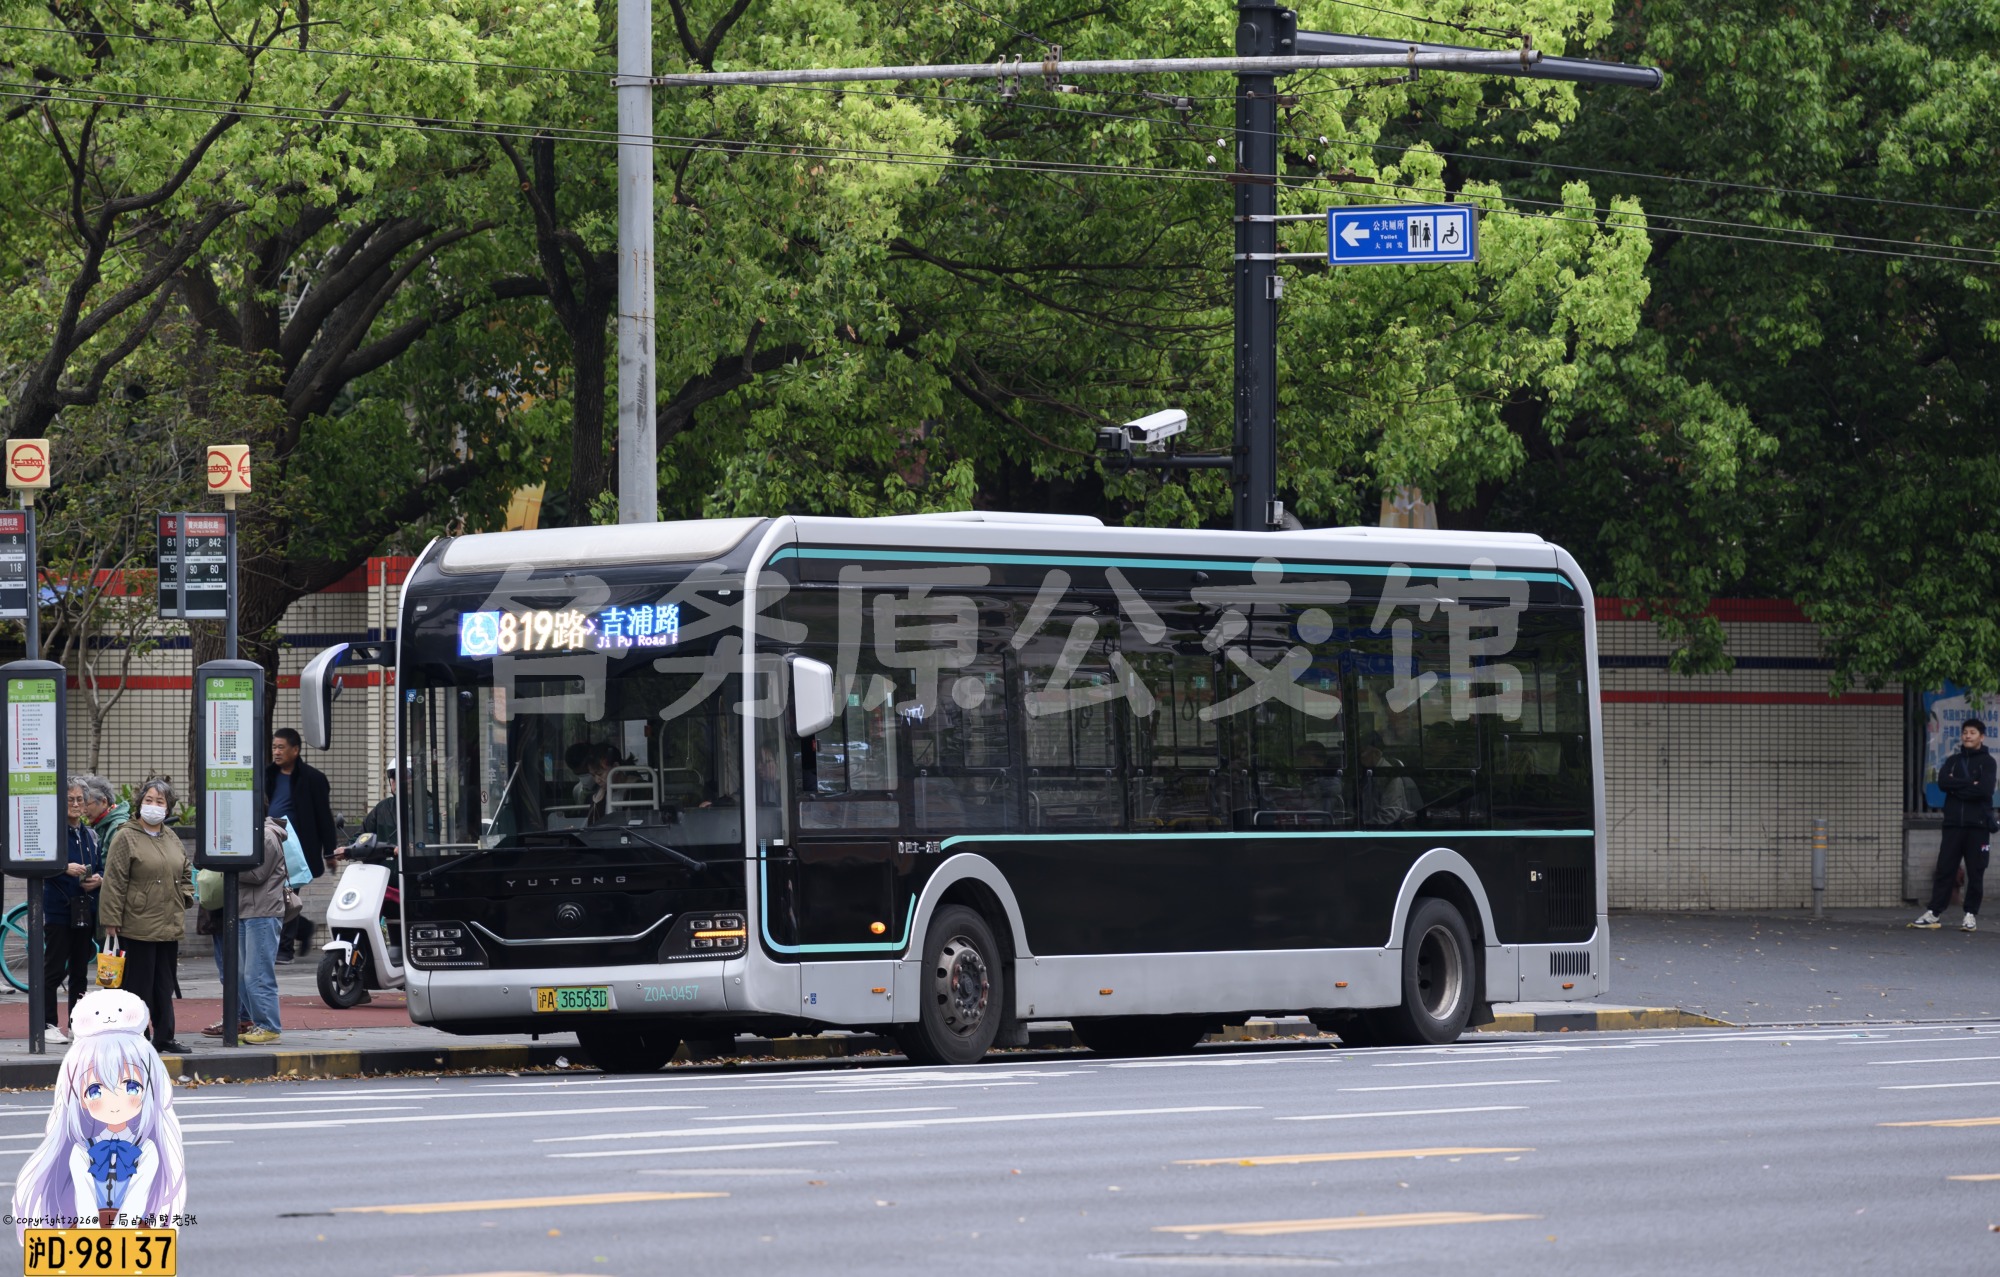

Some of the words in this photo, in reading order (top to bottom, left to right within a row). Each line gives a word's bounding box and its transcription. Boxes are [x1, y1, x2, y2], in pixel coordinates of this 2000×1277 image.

[1372, 219, 1404, 231] 公共厕所
[12, 535, 17, 545] 8
[167, 538, 177, 547] 81
[187, 538, 199, 547] 819
[208, 538, 221, 547] 842
[9, 563, 22, 573] 118
[189, 565, 198, 574] 90
[210, 564, 219, 574] 60
[499, 610, 586, 653] 819路
[601, 604, 679, 637] 吉浦路
[597, 636, 611, 648] Ji
[617, 635, 633, 648] Pu
[638, 634, 667, 646] Road
[17, 681, 24, 690] 8
[213, 679, 225, 688] 60
[13, 773, 31, 783] 118
[210, 769, 228, 778] 819
[506, 876, 626, 888] YUTONG
